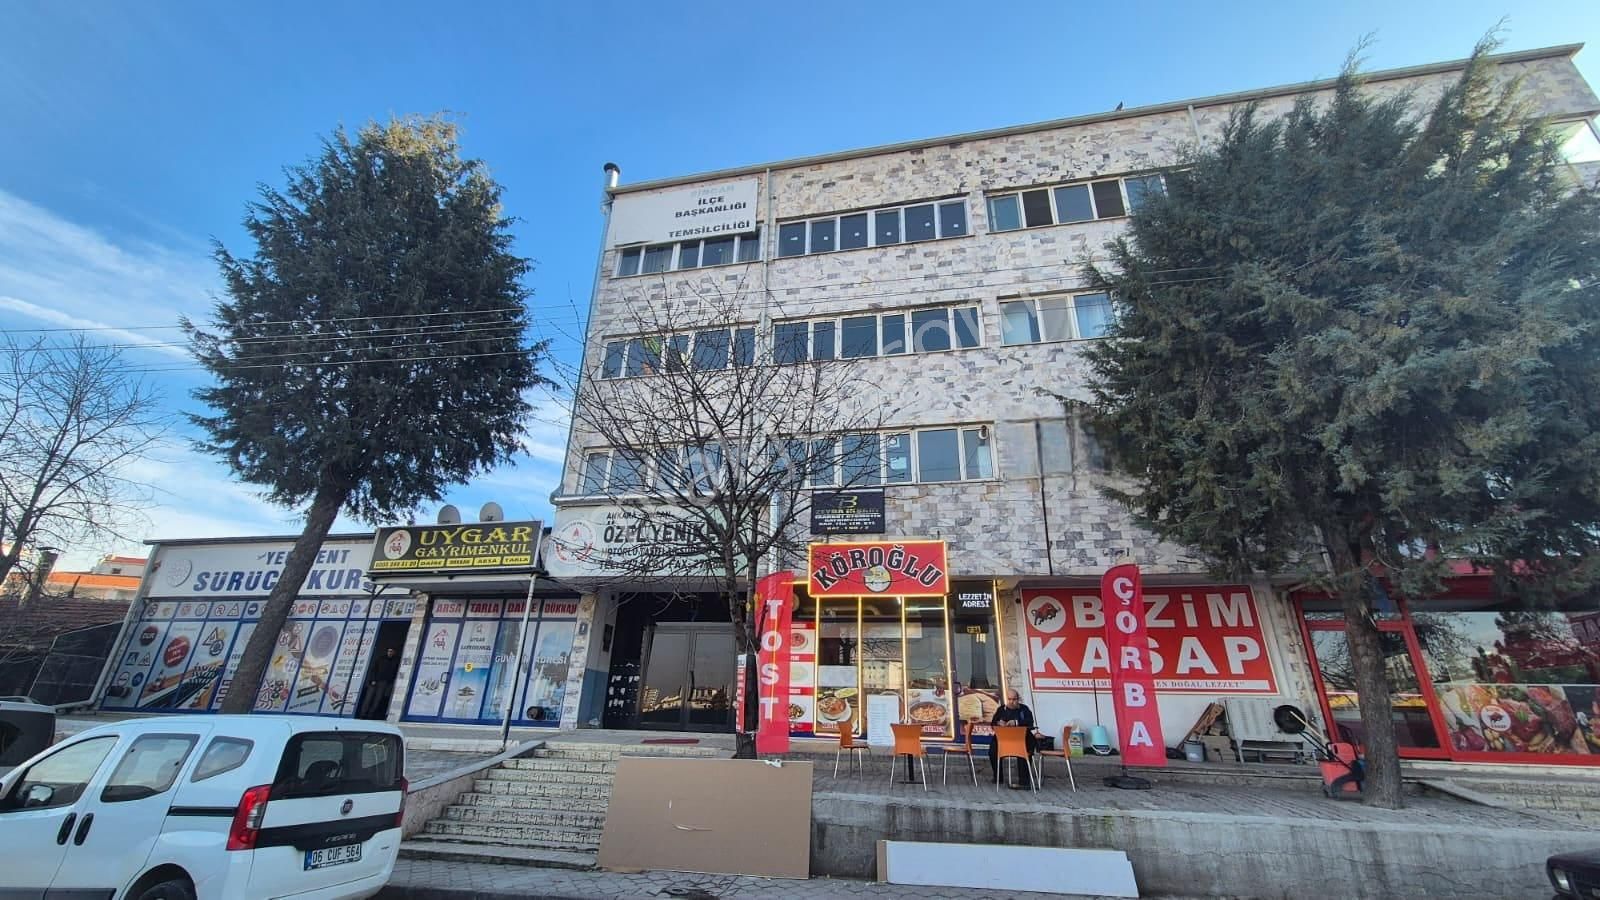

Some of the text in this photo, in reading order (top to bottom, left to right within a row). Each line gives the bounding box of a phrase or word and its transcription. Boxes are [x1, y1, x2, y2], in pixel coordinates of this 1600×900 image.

[698, 195, 726, 206] İLÇE
[674, 202, 747, 219] BAŞKANLIĞI
[669, 221, 750, 238] TEMSİLCİLİĞİ
[418, 526, 533, 546] UYGAR
[603, 520, 647, 544] ÖZEL
[265, 550, 351, 565] YEENT
[414, 542, 531, 558] GAYRİMENKUL
[812, 544, 943, 592] KÖROĞLU
[193, 569, 278, 592] SÜRÜC
[958, 592, 992, 601] LEZZETİN
[435, 602, 462, 613] ARSA
[470, 602, 499, 613] TARLA
[507, 602, 537, 613] DAİE
[1073, 593, 1254, 628] BZİM
[758, 598, 784, 721] TOST
[1112, 576, 1154, 748] ÇORBA
[312, 851, 323, 864] 06
[327, 848, 341, 861] CUF
[346, 845, 360, 858] 564
